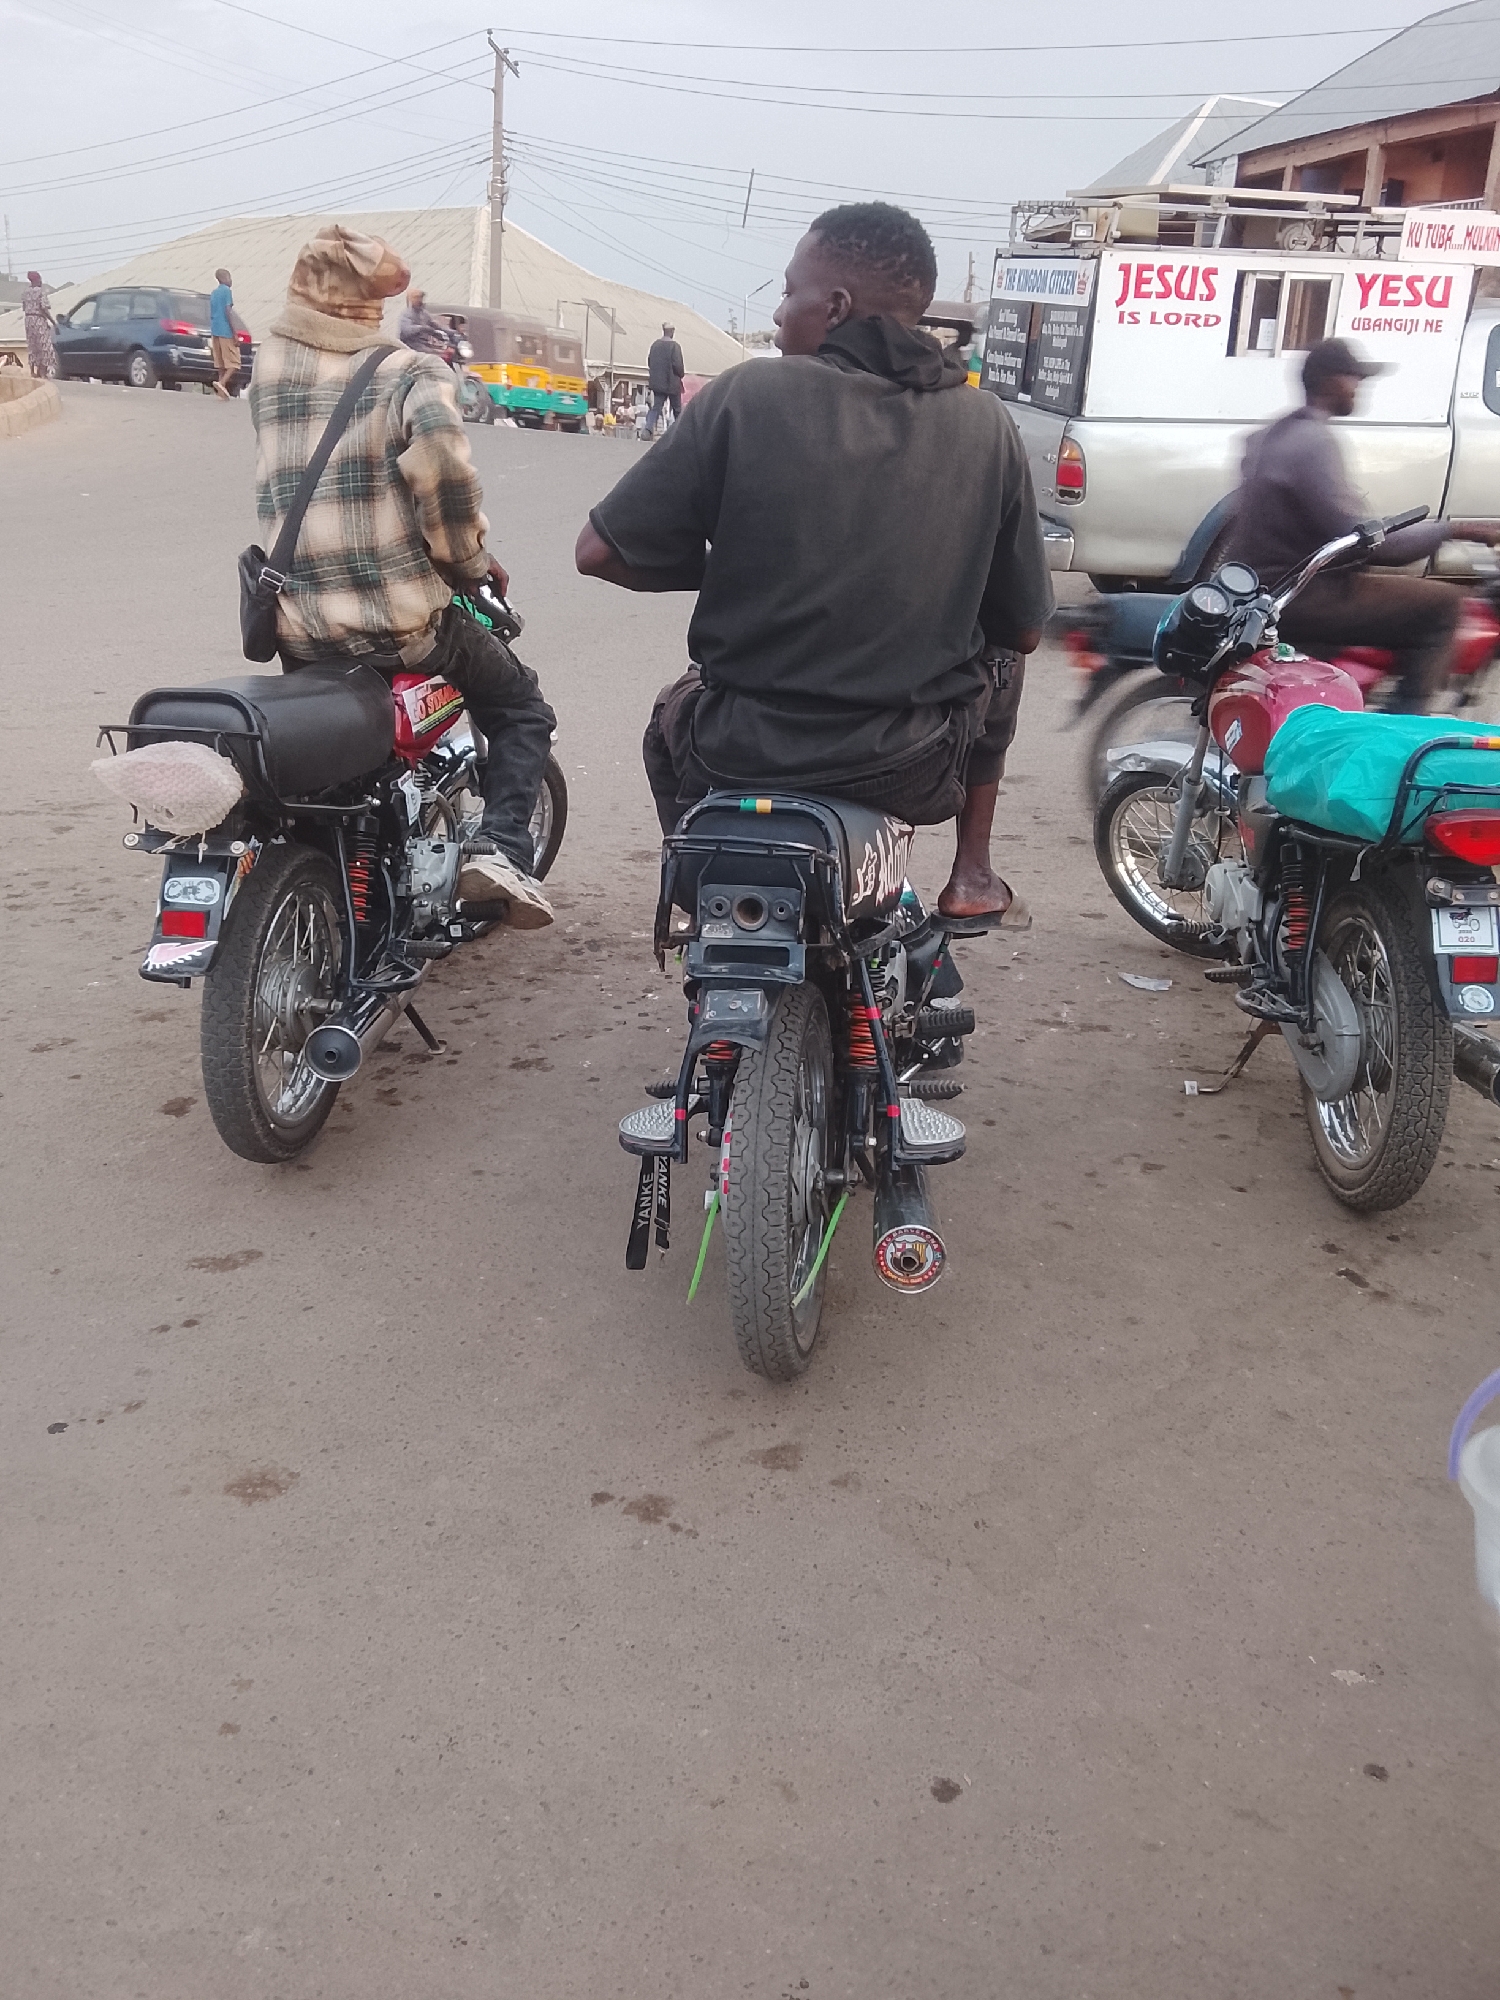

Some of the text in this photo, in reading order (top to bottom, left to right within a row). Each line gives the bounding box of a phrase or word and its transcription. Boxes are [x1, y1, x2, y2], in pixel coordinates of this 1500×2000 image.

[1406, 221, 1424, 248] KU
[1004, 268, 1078, 295] THE KINGDOM CITIZEN
[1115, 263, 1219, 308] JESUS
[1355, 272, 1453, 310] YESU
[1118, 310, 1222, 328] IS LORD
[1351, 317, 1443, 335] UBANGIJI NE
[657, 1156, 669, 1209] YANKE
[637, 1172, 654, 1230] YANKE
